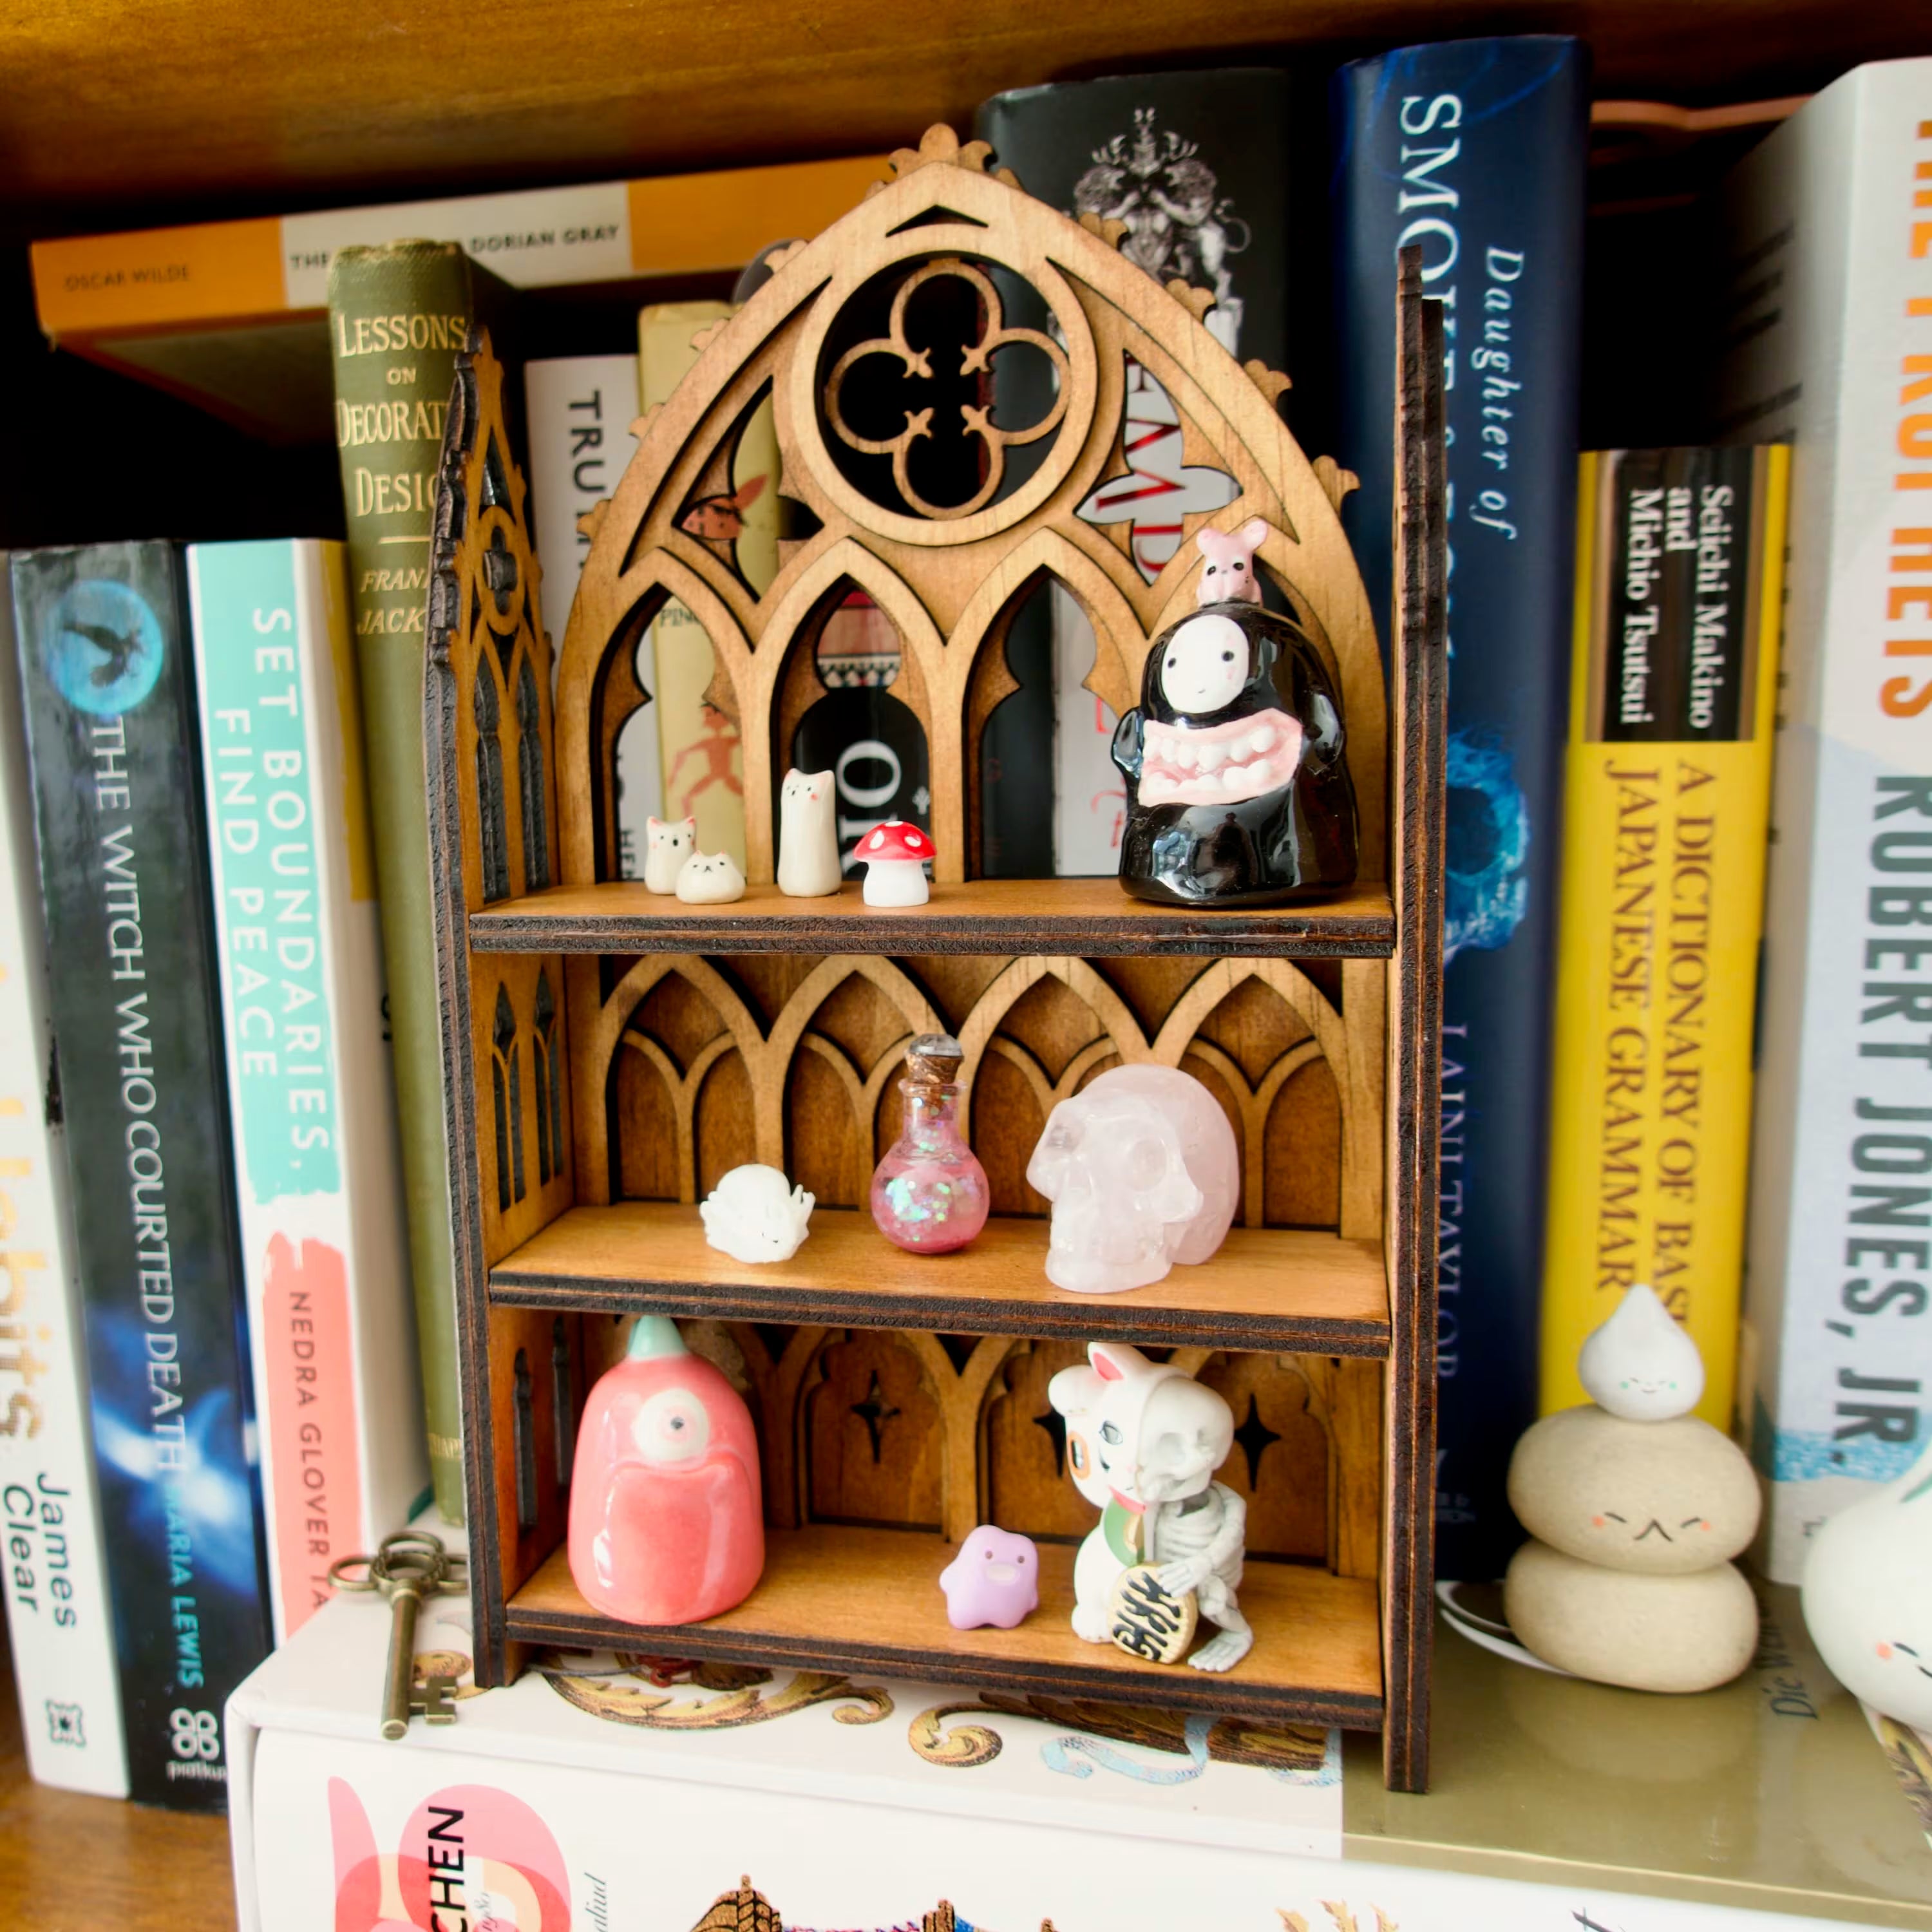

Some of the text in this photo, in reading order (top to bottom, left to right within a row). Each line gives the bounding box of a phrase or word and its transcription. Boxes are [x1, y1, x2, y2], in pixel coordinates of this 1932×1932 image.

[64, 263, 189, 292] OSCAR WILDE
[470, 231, 554, 253] DORIAN
[564, 224, 620, 244] GRAY
[1396, 93, 1463, 390] SMO
[338, 312, 465, 357] LESSONS
[386, 366, 417, 385] ON
[1468, 243, 1524, 540] Daughter of
[361, 566, 431, 593] FRAN
[1665, 486, 1698, 552] and
[1620, 486, 1665, 725] Michio Tsutsui
[1689, 484, 1734, 730] Seiichi Makino
[1677, 759, 1717, 795] A
[214, 708, 278, 1077] FIND PEACE
[252, 607, 330, 1170] SET BOUNDARIES,
[1597, 758, 1660, 1289] JAPANESE GRAMMAR
[1662, 813, 1714, 1128] DICTIONARY
[90, 715, 187, 1472] THE WITCH WHO COURTED DEATH
[1657, 1137, 1698, 1204] OF
[1824, 776, 1932, 1465] ROBERT JONES, JR.
[289, 1291, 317, 1408] NEDRA
[3, 1484, 39, 1614] Clear
[37, 1472, 77, 1629] James
[299, 1423, 330, 1557] GLOVER
[162, 1481, 205, 1690] MARIA LEWIS
